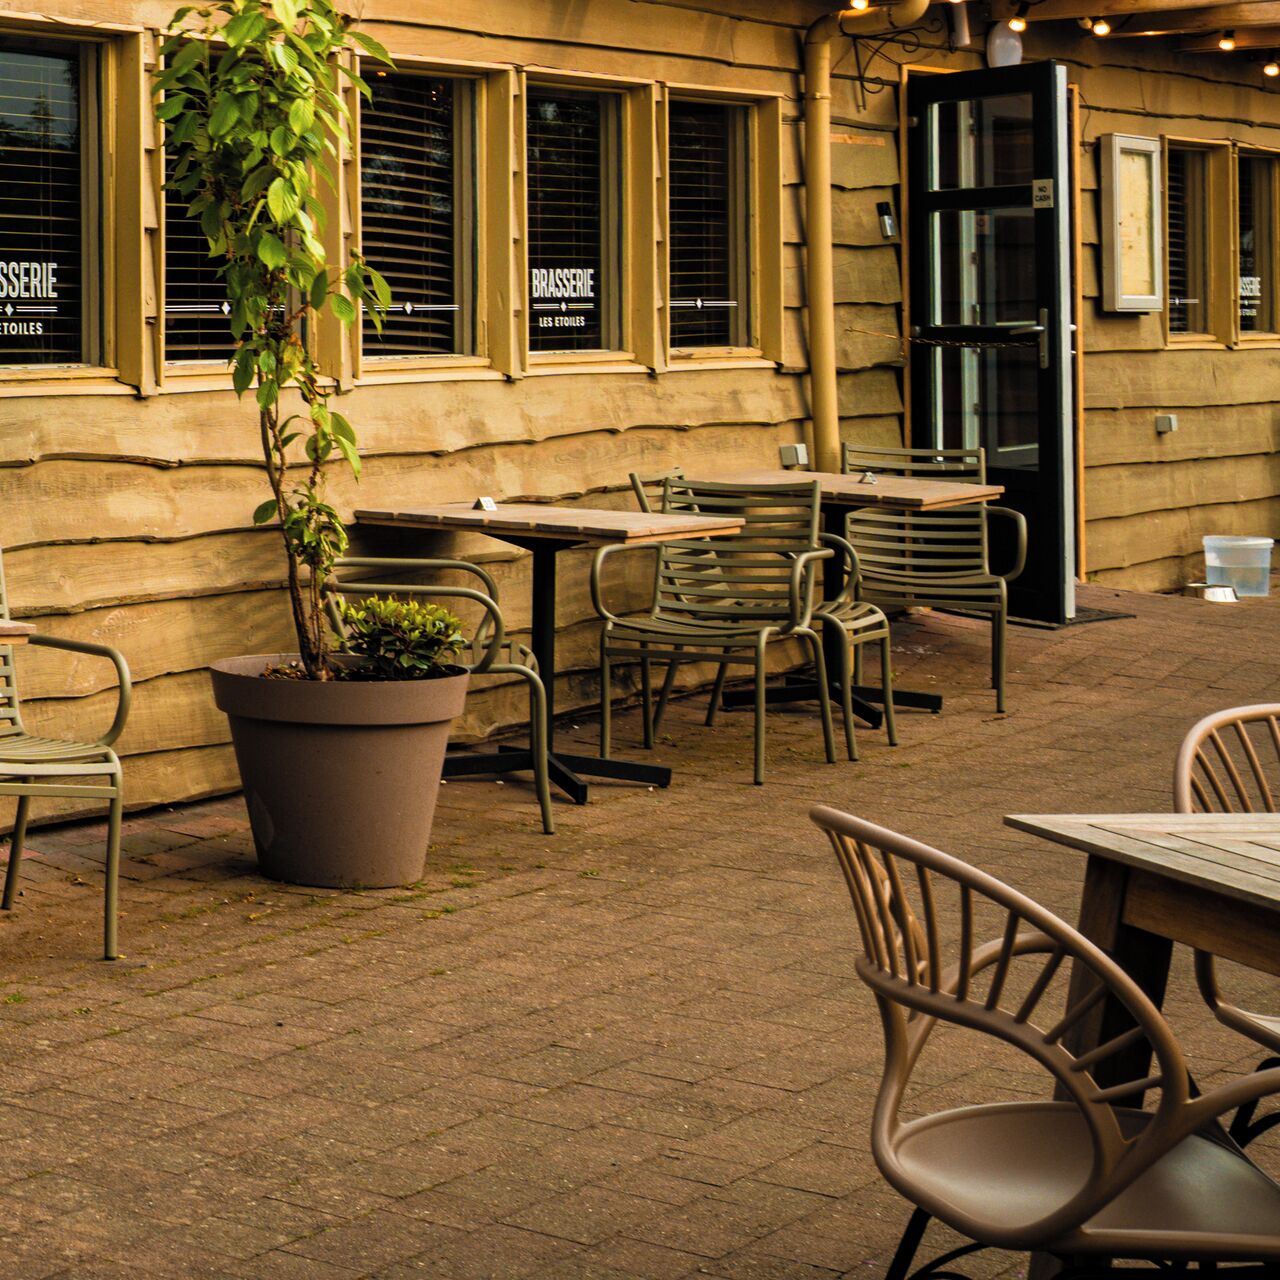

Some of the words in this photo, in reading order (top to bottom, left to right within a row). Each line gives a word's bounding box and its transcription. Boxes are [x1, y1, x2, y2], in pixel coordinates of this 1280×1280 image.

[532, 268, 594, 298] BRASSERIE
[539, 317, 553, 327] LES
[555, 316, 585, 327] ETOILES
